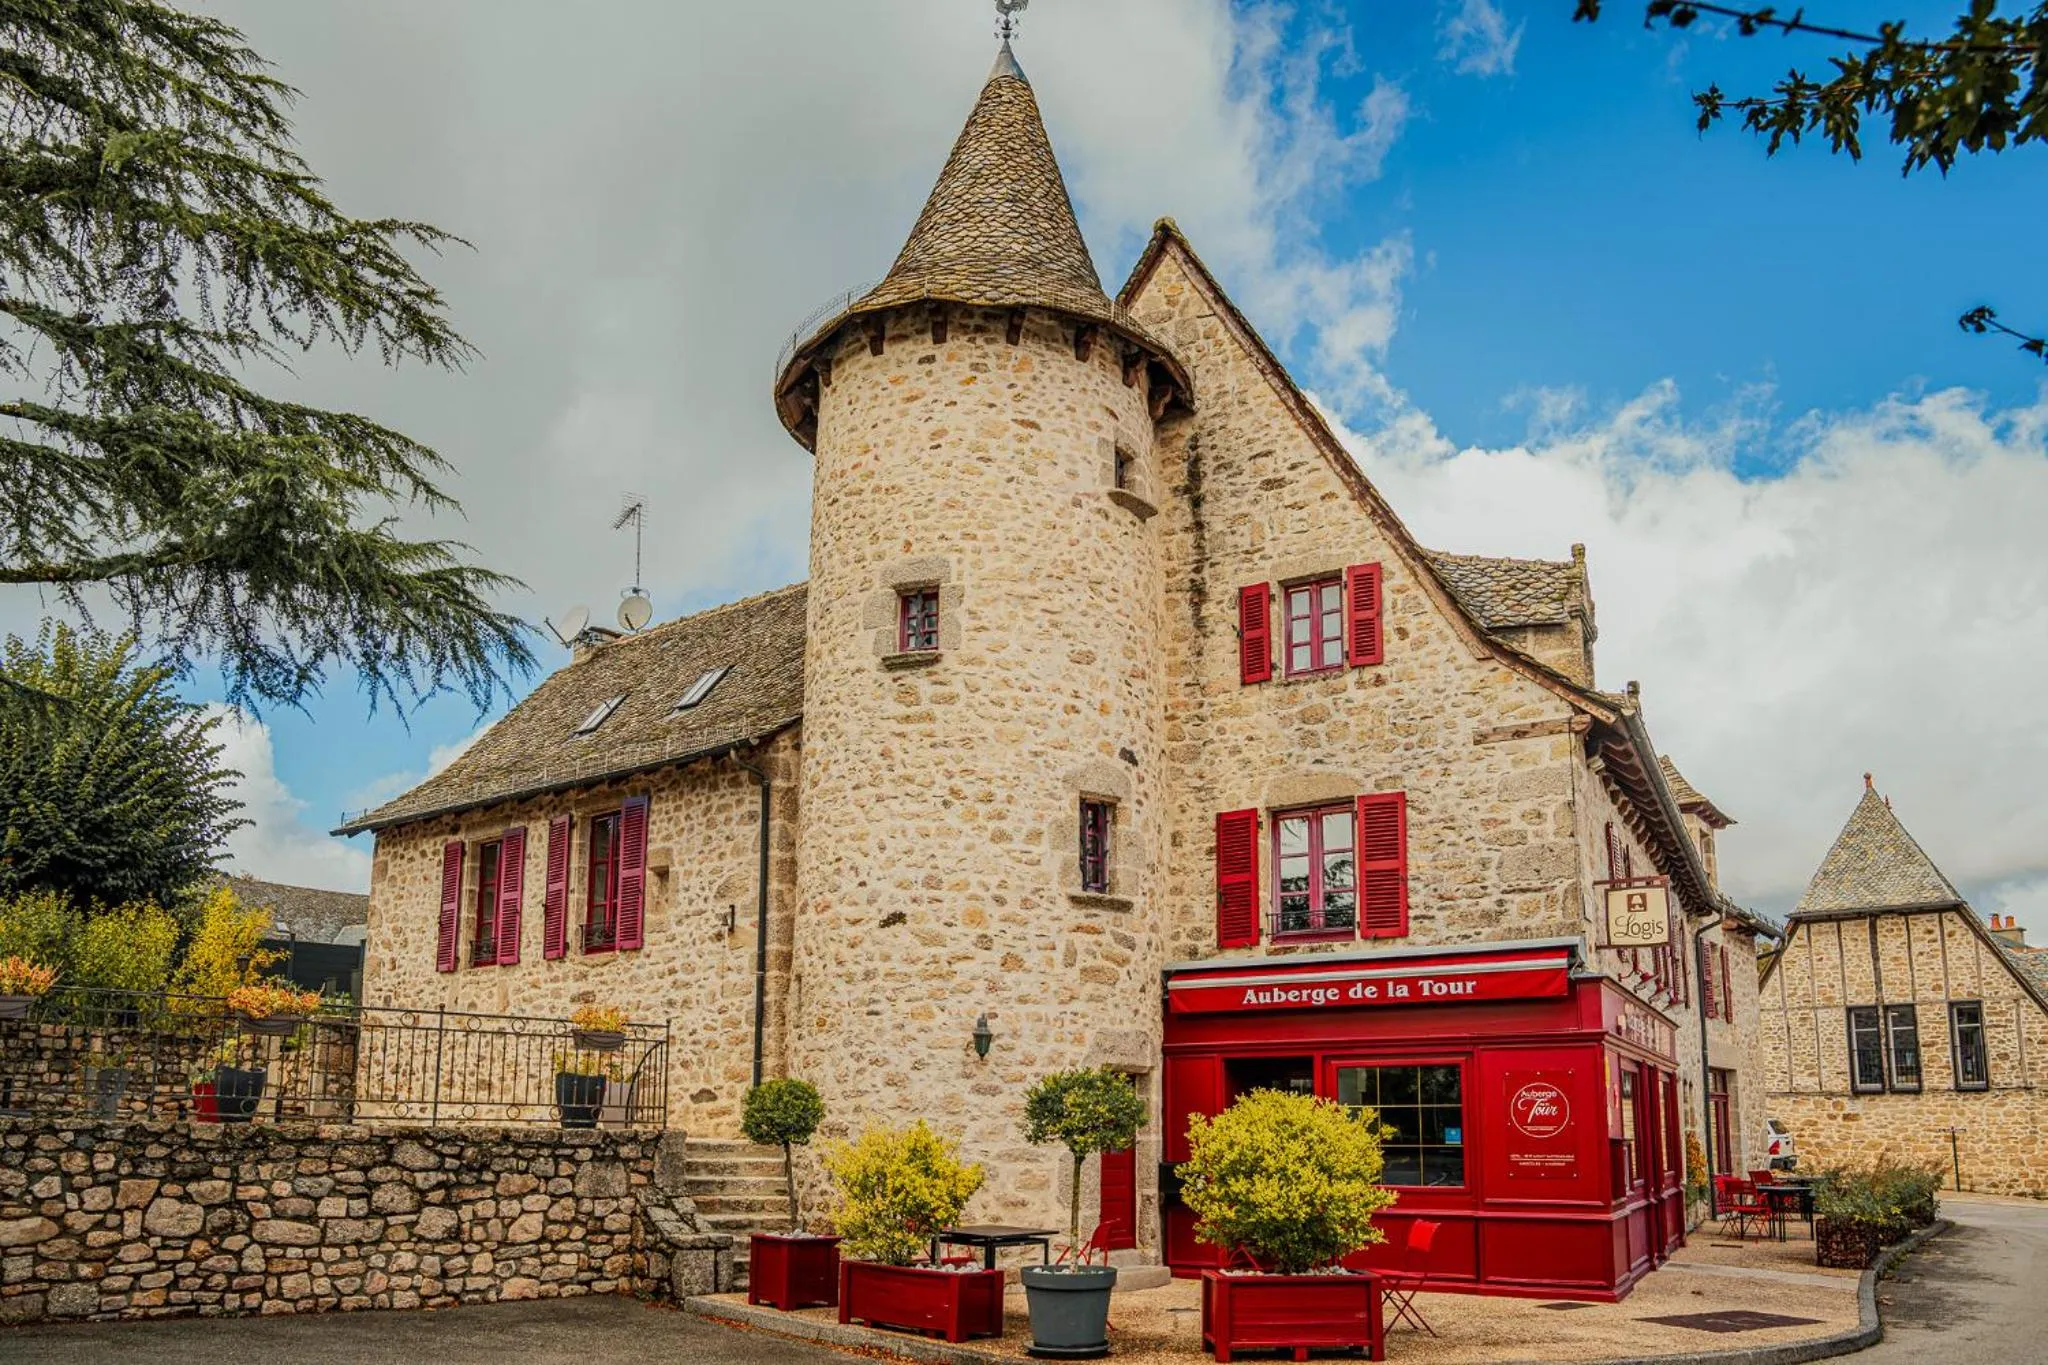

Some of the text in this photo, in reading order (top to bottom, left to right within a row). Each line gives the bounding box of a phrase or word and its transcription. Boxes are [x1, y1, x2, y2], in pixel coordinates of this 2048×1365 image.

[1613, 914, 1664, 940] Logis
[1242, 979, 1477, 1005] Auberge de la Tour
[1517, 1098, 1558, 1123] Tour
